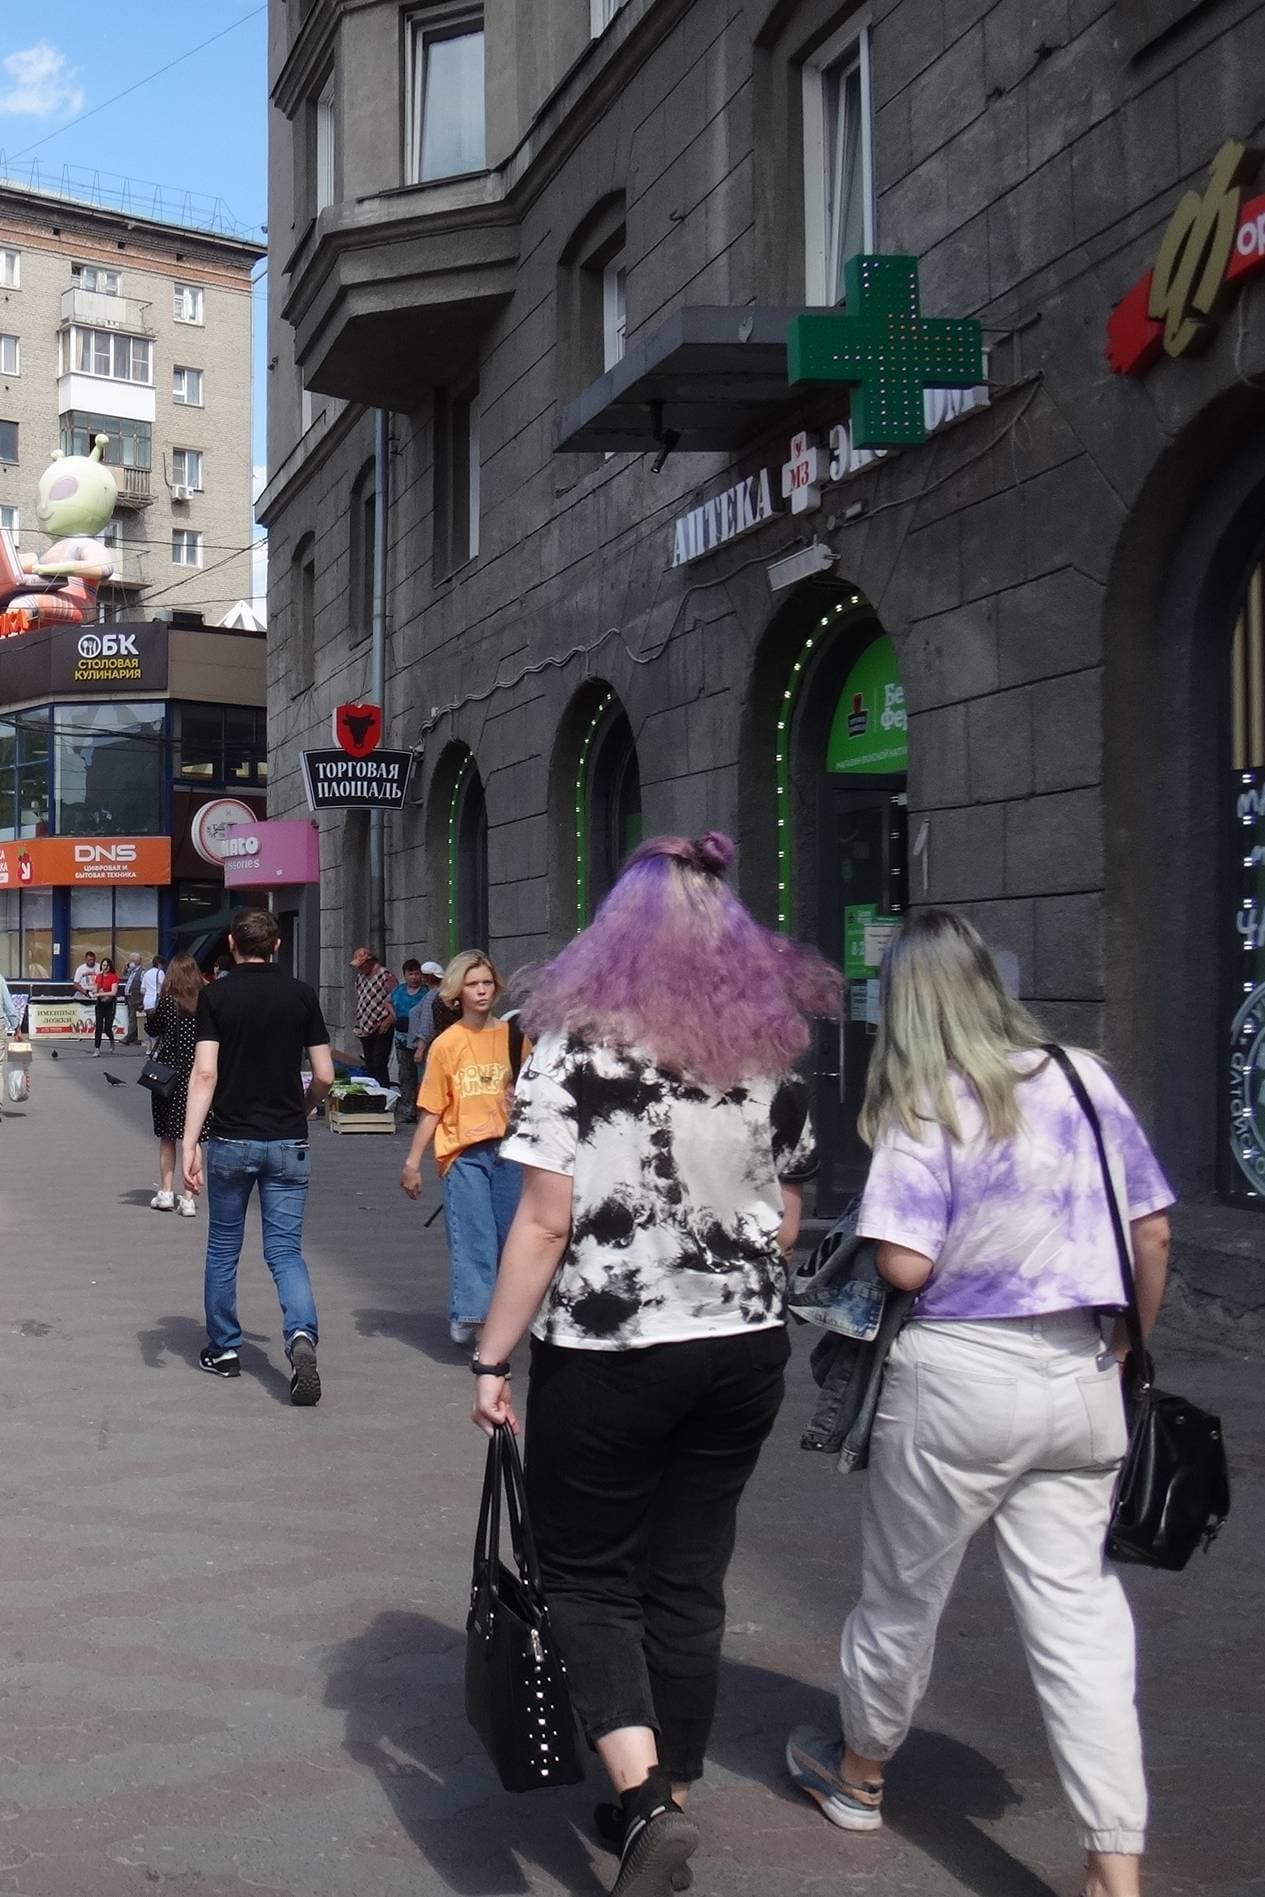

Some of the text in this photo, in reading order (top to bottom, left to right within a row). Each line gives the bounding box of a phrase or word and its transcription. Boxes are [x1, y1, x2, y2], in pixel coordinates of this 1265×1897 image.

[672, 468, 773, 568] АПТЕКА
[78, 658, 139, 669] СТОЛОВАЯ
[75, 669, 141, 680] КУЛИНАРИЯ
[316, 761, 400, 779] ТОРГОВАЯ
[317, 780, 402, 799] ПЛОЩАДЬ
[75, 845, 137, 862] DNS
